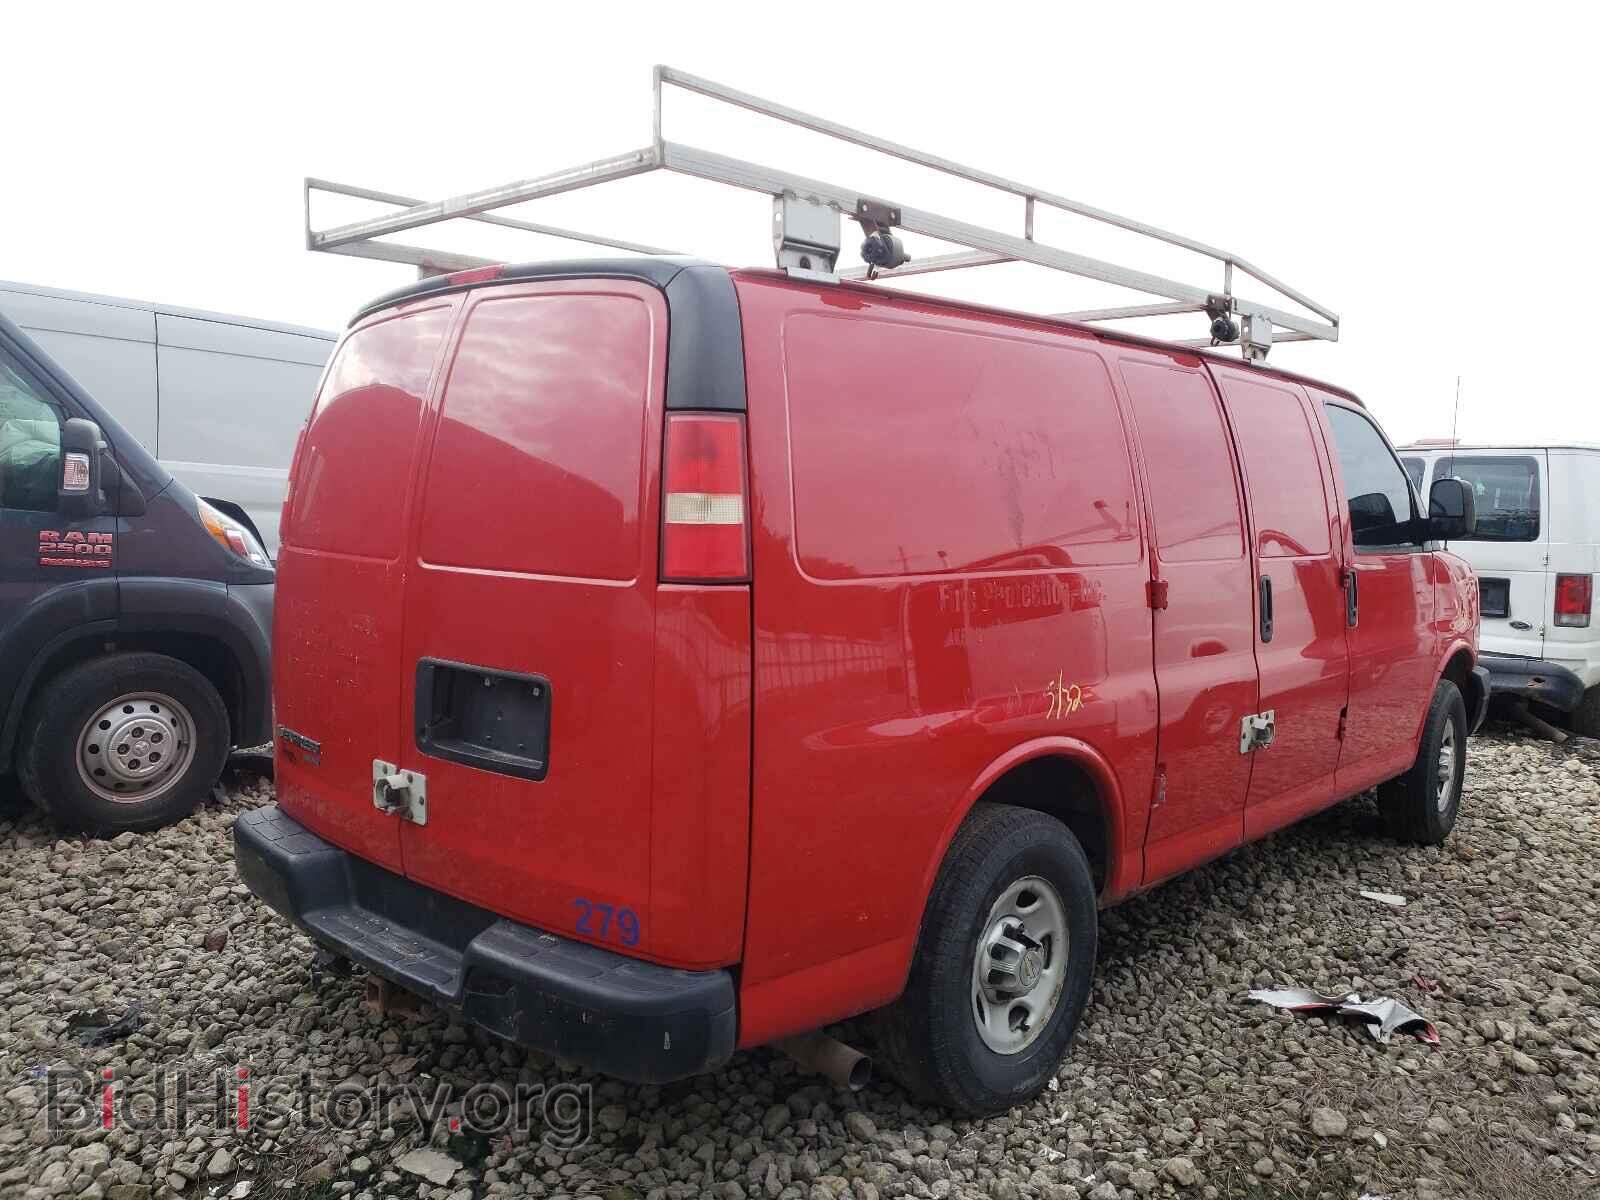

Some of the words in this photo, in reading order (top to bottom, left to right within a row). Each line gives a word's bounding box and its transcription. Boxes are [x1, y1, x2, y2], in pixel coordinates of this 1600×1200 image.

[39, 531, 113, 543] RAM
[39, 542, 112, 554] 2500
[571, 898, 641, 947] 279
